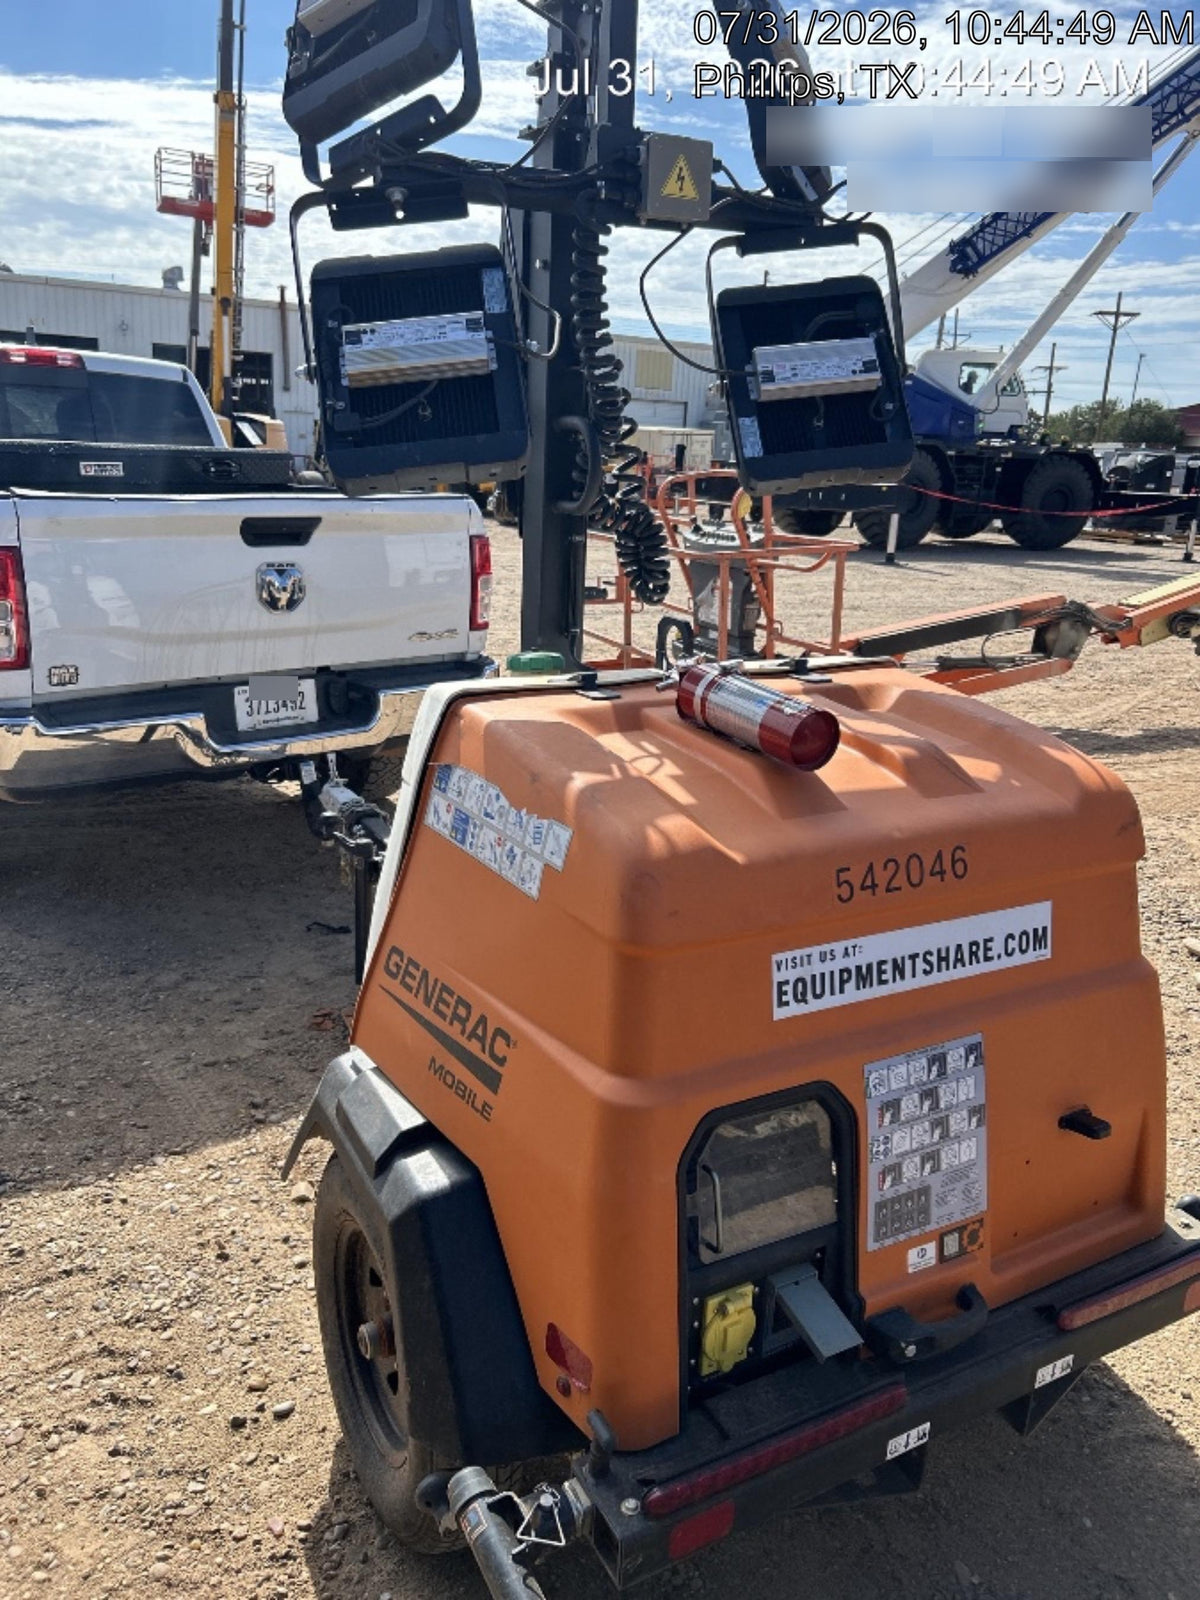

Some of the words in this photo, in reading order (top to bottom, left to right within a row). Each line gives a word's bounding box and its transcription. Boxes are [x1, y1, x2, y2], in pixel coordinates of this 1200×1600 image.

[835, 844, 969, 904] 542046
[775, 953, 813, 973] VISIT
[819, 949, 836, 964] US
[842, 943, 864, 959] AT:
[776, 925, 1049, 1009] EQUIPMENTSHARE.COM
[383, 945, 512, 1068] GENERAC
[427, 1056, 494, 1122] MOBILE
